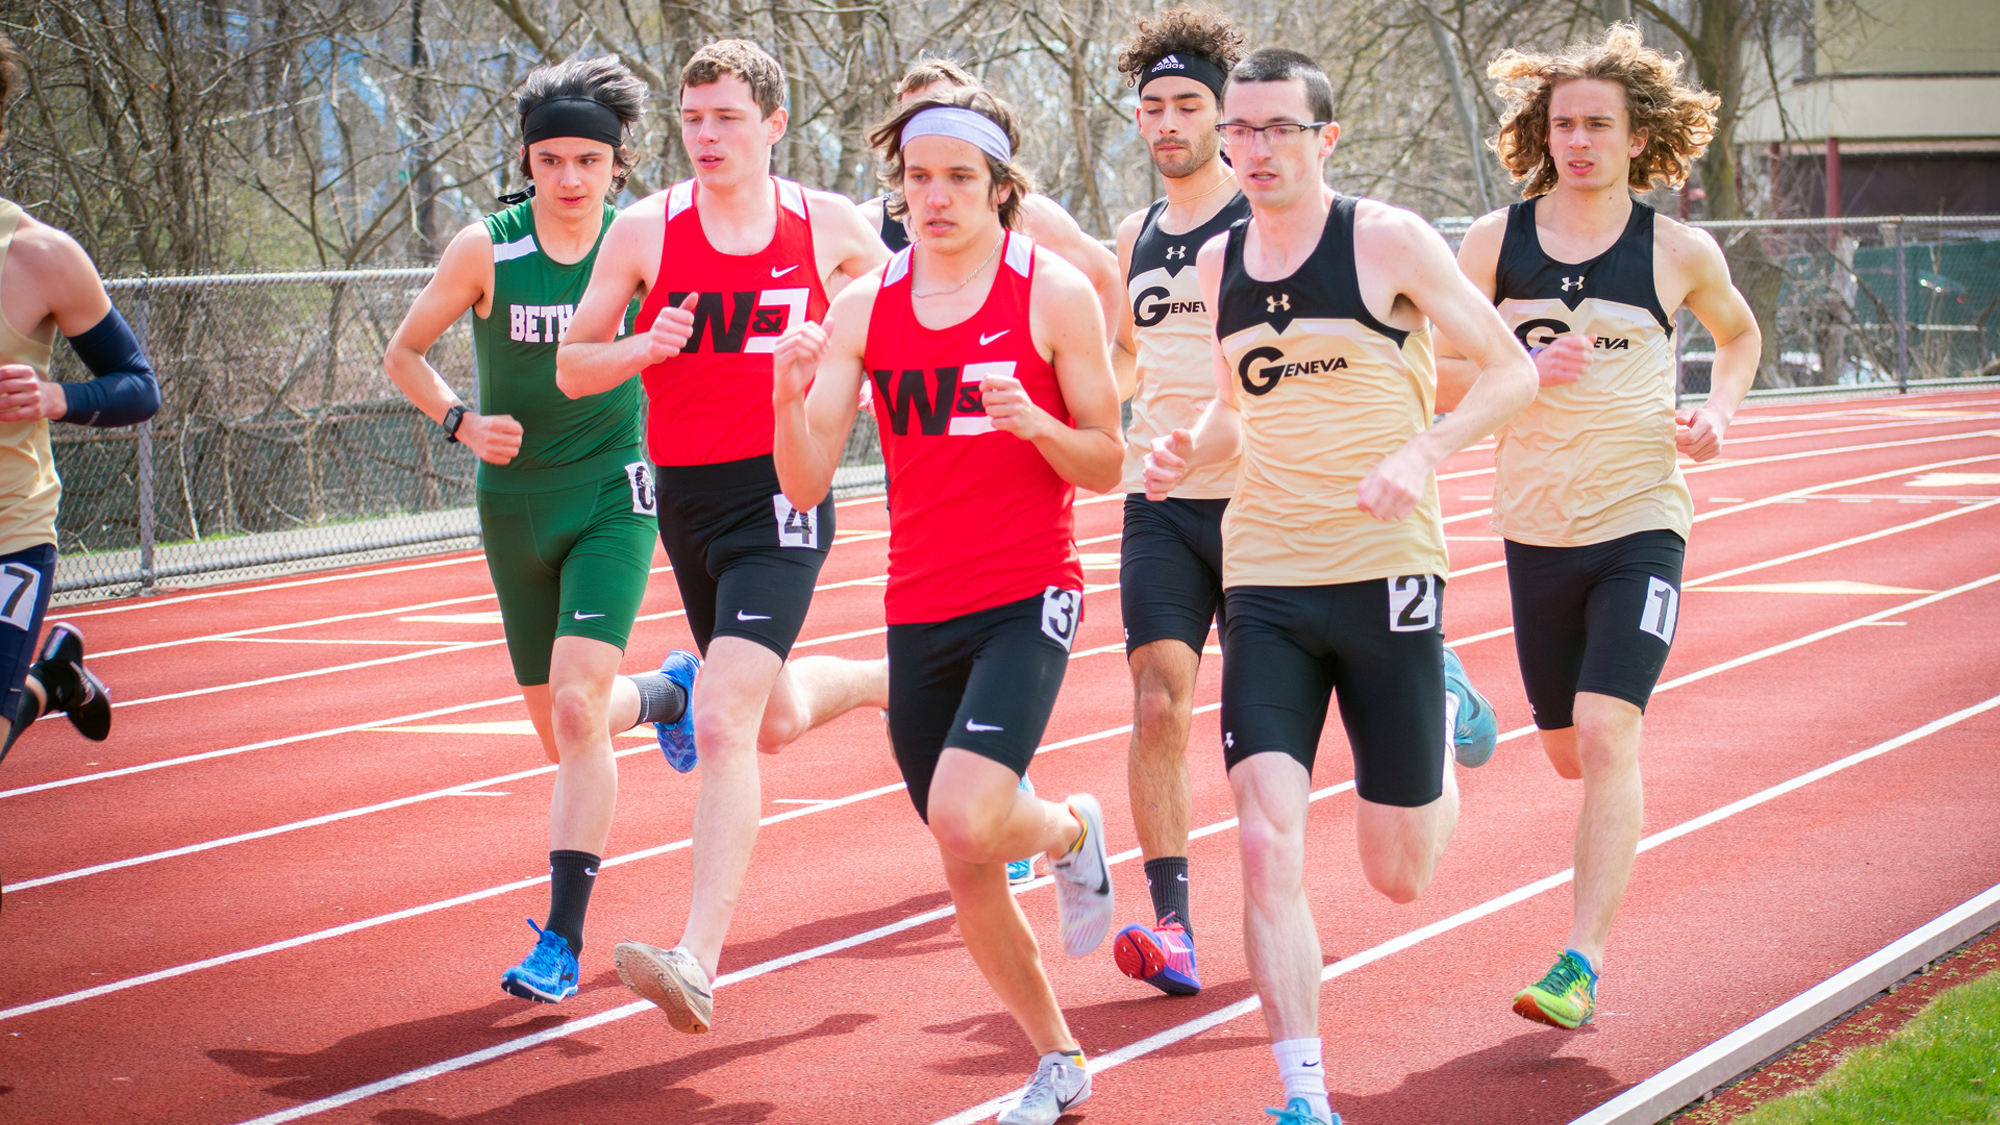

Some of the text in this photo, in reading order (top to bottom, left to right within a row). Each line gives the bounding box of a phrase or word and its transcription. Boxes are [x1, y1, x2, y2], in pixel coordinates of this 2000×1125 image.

[1151, 62, 1185, 73] adidas
[510, 303, 629, 343] BETH
[1513, 318, 1629, 353] GEVA
[1238, 346, 1348, 396] GENEVA
[784, 506, 813, 545] 4
[1, 564, 35, 619] 7
[1048, 588, 1074, 641] 3
[1395, 574, 1429, 627] 2
[1654, 587, 1671, 635] 1
